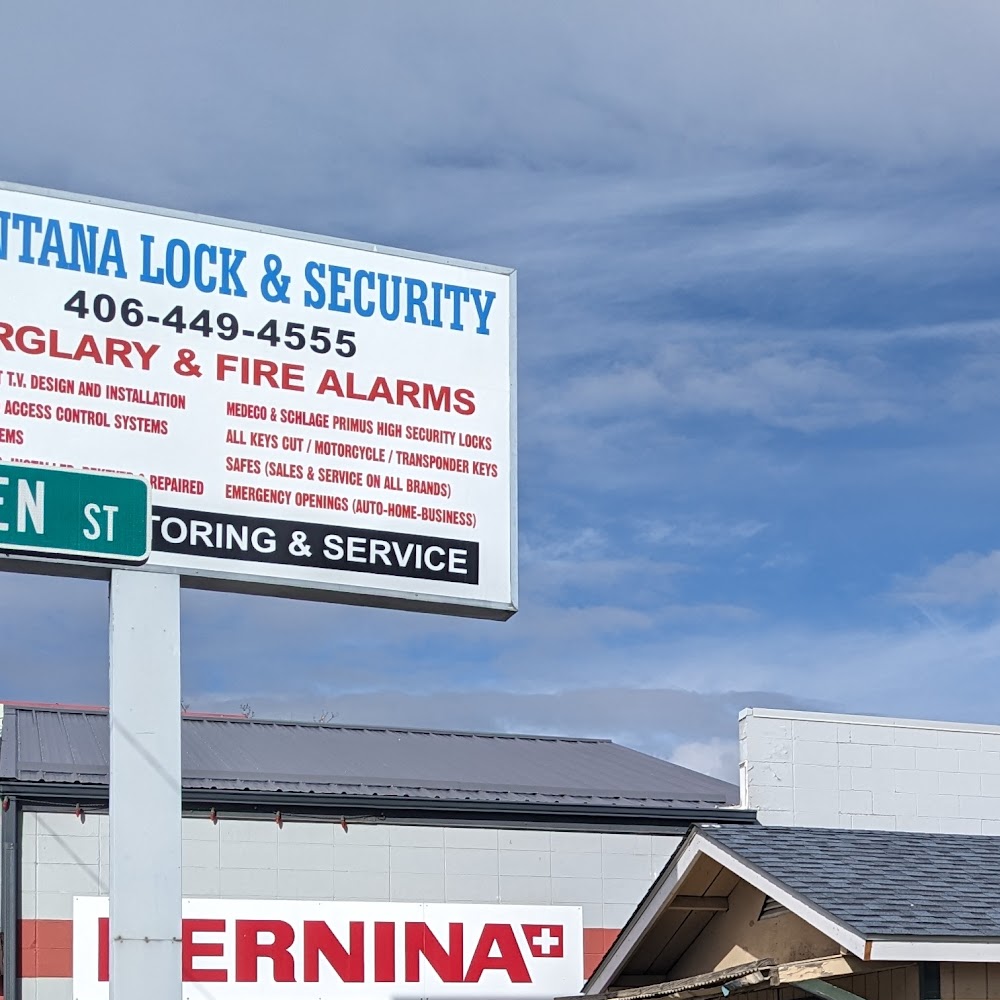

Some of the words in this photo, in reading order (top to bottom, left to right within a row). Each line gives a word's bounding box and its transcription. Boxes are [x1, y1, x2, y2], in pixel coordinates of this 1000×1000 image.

[140, 233, 248, 298] LOCK
[261, 253, 291, 304] &
[304, 261, 497, 335] SECURITY
[64, 289, 357, 358] 406-449-4555
[6, 371, 27, 388] T.V.
[30, 375, 75, 395] DESIGN
[78, 381, 101, 398] AND
[106, 385, 186, 410] INSTALLATION
[173, 348, 203, 378] &
[216, 353, 306, 393] FIRE
[316, 369, 476, 416] ALARMS
[0, 427, 24, 445] EMS
[4, 399, 52, 420] ACCESS
[56, 406, 111, 428] CONTROL
[114, 414, 169, 435] SYSTEMS
[226, 401, 267, 421] MEDECO
[270, 407, 277, 422] &
[280, 408, 330, 429] SCHLAGE
[332, 415, 374, 435] PRIMUS
[376, 421, 402, 439] HIGH
[405, 425, 456, 446] SECURITY
[458, 432, 492, 451] LOCKS
[225, 428, 247, 445] ALL
[250, 431, 279, 449] KEYS
[282, 435, 304, 452] CUT
[306, 439, 312, 454] /
[314, 439, 386, 463] MOTORCYCLE
[388, 449, 393, 464] /
[395, 450, 469, 474] TRANSPONDER
[472, 460, 498, 478] KEYS
[149, 474, 204, 495] REPAIRED
[225, 456, 261, 475] SAFES
[264, 460, 304, 480] (SALES
[307, 466, 315, 480] &
[317, 467, 363, 487] SERVICE
[366, 473, 381, 488] ON
[383, 475, 403, 491] ALL
[406, 478, 451, 499] BRANDS)
[82, 502, 119, 542] ST
[225, 483, 292, 506] EMERGENCY
[294, 491, 348, 512] OPENINGS
[352, 498, 477, 529] (AUTO-HOME-BUSINESS)
[152, 515, 277, 554] ORING
[288, 530, 312, 558] &
[323, 533, 468, 575] SERVICE
[98, 917, 532, 984] ERNINA
